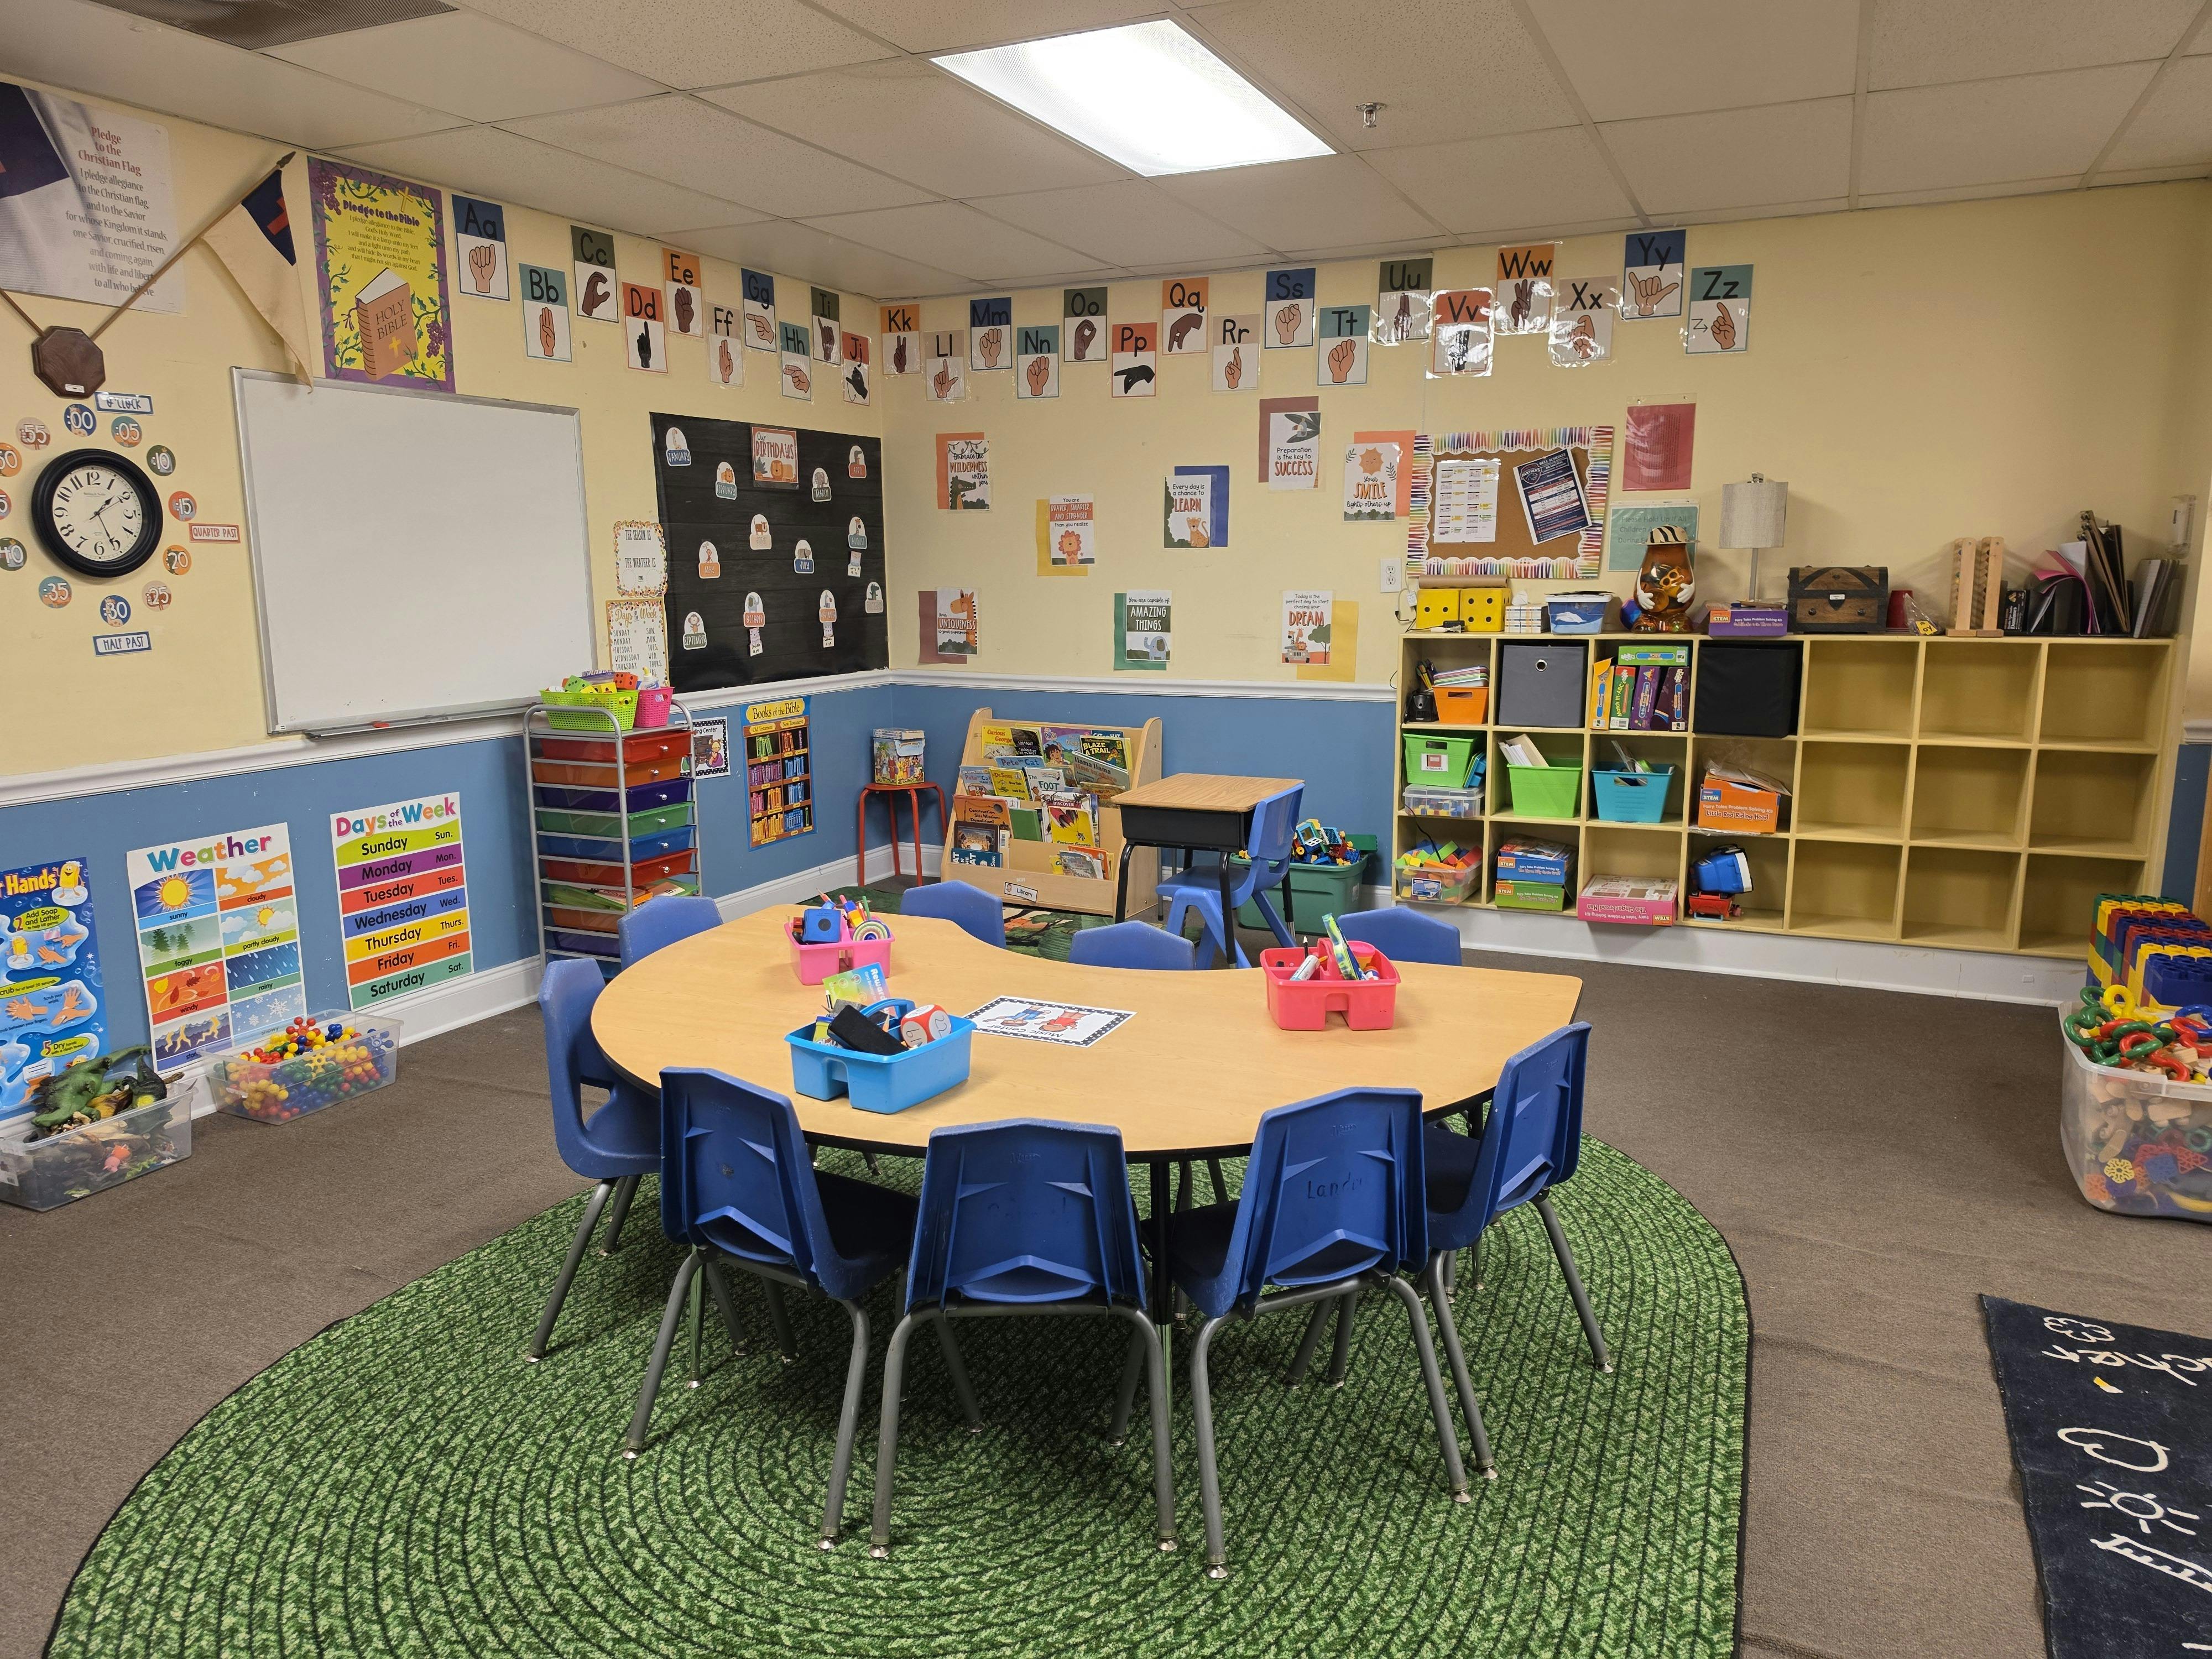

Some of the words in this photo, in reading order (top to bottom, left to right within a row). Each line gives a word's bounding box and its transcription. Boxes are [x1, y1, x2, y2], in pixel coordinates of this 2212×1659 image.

[91, 126, 121, 144] Pledge
[95, 141, 106, 152] to
[107, 142, 122, 156] the
[79, 149, 121, 170] Christian
[122, 160, 142, 176] Flag
[80, 168, 83, 177] I
[85, 169, 107, 184] pledge
[108, 174, 143, 191] allegiance
[343, 200, 374, 218] Pledge
[375, 208, 384, 218] to
[385, 211, 399, 221] the
[399, 213, 420, 227] Bible
[465, 202, 496, 240] Aa
[580, 232, 607, 266] Cc
[1637, 236, 1671, 271] Yy
[670, 253, 694, 285] Ee
[1500, 250, 1552, 279] Ww
[529, 268, 559, 303] Bb
[1389, 264, 1421, 291] Uu
[1703, 272, 1739, 300] Zz
[1276, 274, 1304, 300] Ss
[1571, 282, 1603, 310] Xx
[630, 288, 656, 320] Dd
[1071, 293, 1099, 316] Oo
[1170, 283, 1204, 313] Qq
[376, 299, 404, 325] HOLY
[1447, 295, 1480, 322] Vv
[378, 314, 407, 340] BIBLE
[714, 306, 734, 336] Ff
[888, 309, 911, 332] Kk
[1332, 310, 1358, 336] Tt
[785, 327, 805, 354] Hh
[1223, 319, 1250, 345] Rr
[1025, 330, 1051, 354] Nn
[1121, 327, 1147, 357] Pp
[850, 337, 863, 367] Jj
[66, 411, 93, 429] :00
[116, 423, 139, 439] :05
[757, 432, 765, 441] Our
[668, 451, 690, 462] JANUARY
[755, 441, 794, 459] BIRTHDAYS
[153, 453, 170, 469] :10
[950, 461, 987, 473] WILDERNESS
[1275, 461, 1313, 476] SUCCESS
[86, 472, 101, 486] 12
[57, 487, 72, 502] 10
[1353, 482, 1387, 499] SMILE
[176, 498, 191, 514] :15
[1175, 498, 1201, 512] LEARN
[60, 524, 74, 536] 8
[192, 528, 221, 538] QUARTER
[223, 528, 237, 539] PAST
[633, 530, 646, 540] SEASON
[647, 530, 651, 540] IS
[94, 541, 105, 555] 6
[166, 552, 189, 569] :20
[633, 558, 650, 568] WEATHER
[652, 558, 656, 567] IS
[800, 561, 810, 570] JULY
[43, 582, 68, 601] :35
[103, 602, 128, 618] :30
[1131, 607, 1166, 617] AMAZING
[1289, 611, 1324, 626] DREAM
[939, 619, 975, 630] UNIQUENESS
[1136, 620, 1161, 630] THINGS
[103, 639, 122, 650] HALF
[126, 637, 144, 648] PAST
[685, 635, 706, 646] SEPTEMBER
[753, 706, 771, 719] Books
[773, 707, 777, 716] of
[785, 702, 800, 714] Bible
[1039, 781, 1060, 790] FOOT
[390, 809, 399, 818] of
[401, 797, 456, 823] Week
[336, 815, 387, 837] Days
[388, 819, 402, 827] the
[362, 837, 408, 855] Sunday
[435, 831, 453, 839] Sun.
[147, 834, 272, 873] Weather
[362, 860, 412, 880] Monday
[436, 853, 456, 863] Mon.
[4, 873, 56, 896] Hands
[364, 884, 414, 903] Tuesday
[438, 875, 457, 885] Tues.
[1017, 888, 1033, 898] Library
[247, 893, 266, 902] cloudy
[26, 910, 40, 919] Add
[42, 908, 58, 917] Soap
[169, 911, 187, 920] sunny
[355, 904, 426, 930] Wednesday
[440, 896, 460, 907] Wed.
[1600, 904, 1634, 912] Gingerbread
[15, 917, 23, 931] 2
[40, 914, 60, 924] Lather
[243, 940, 259, 950] partly
[261, 936, 279, 946] cloudy
[366, 928, 421, 951] Thursday
[441, 919, 463, 930] Thurs.
[175, 958, 192, 967] foggy
[378, 952, 414, 971] Friday
[448, 941, 460, 950] Fri.
[371, 972, 425, 997] Saturday
[448, 963, 463, 972] Sat.
[180, 1004, 199, 1013] windy
[44, 1041, 51, 1056] 5
